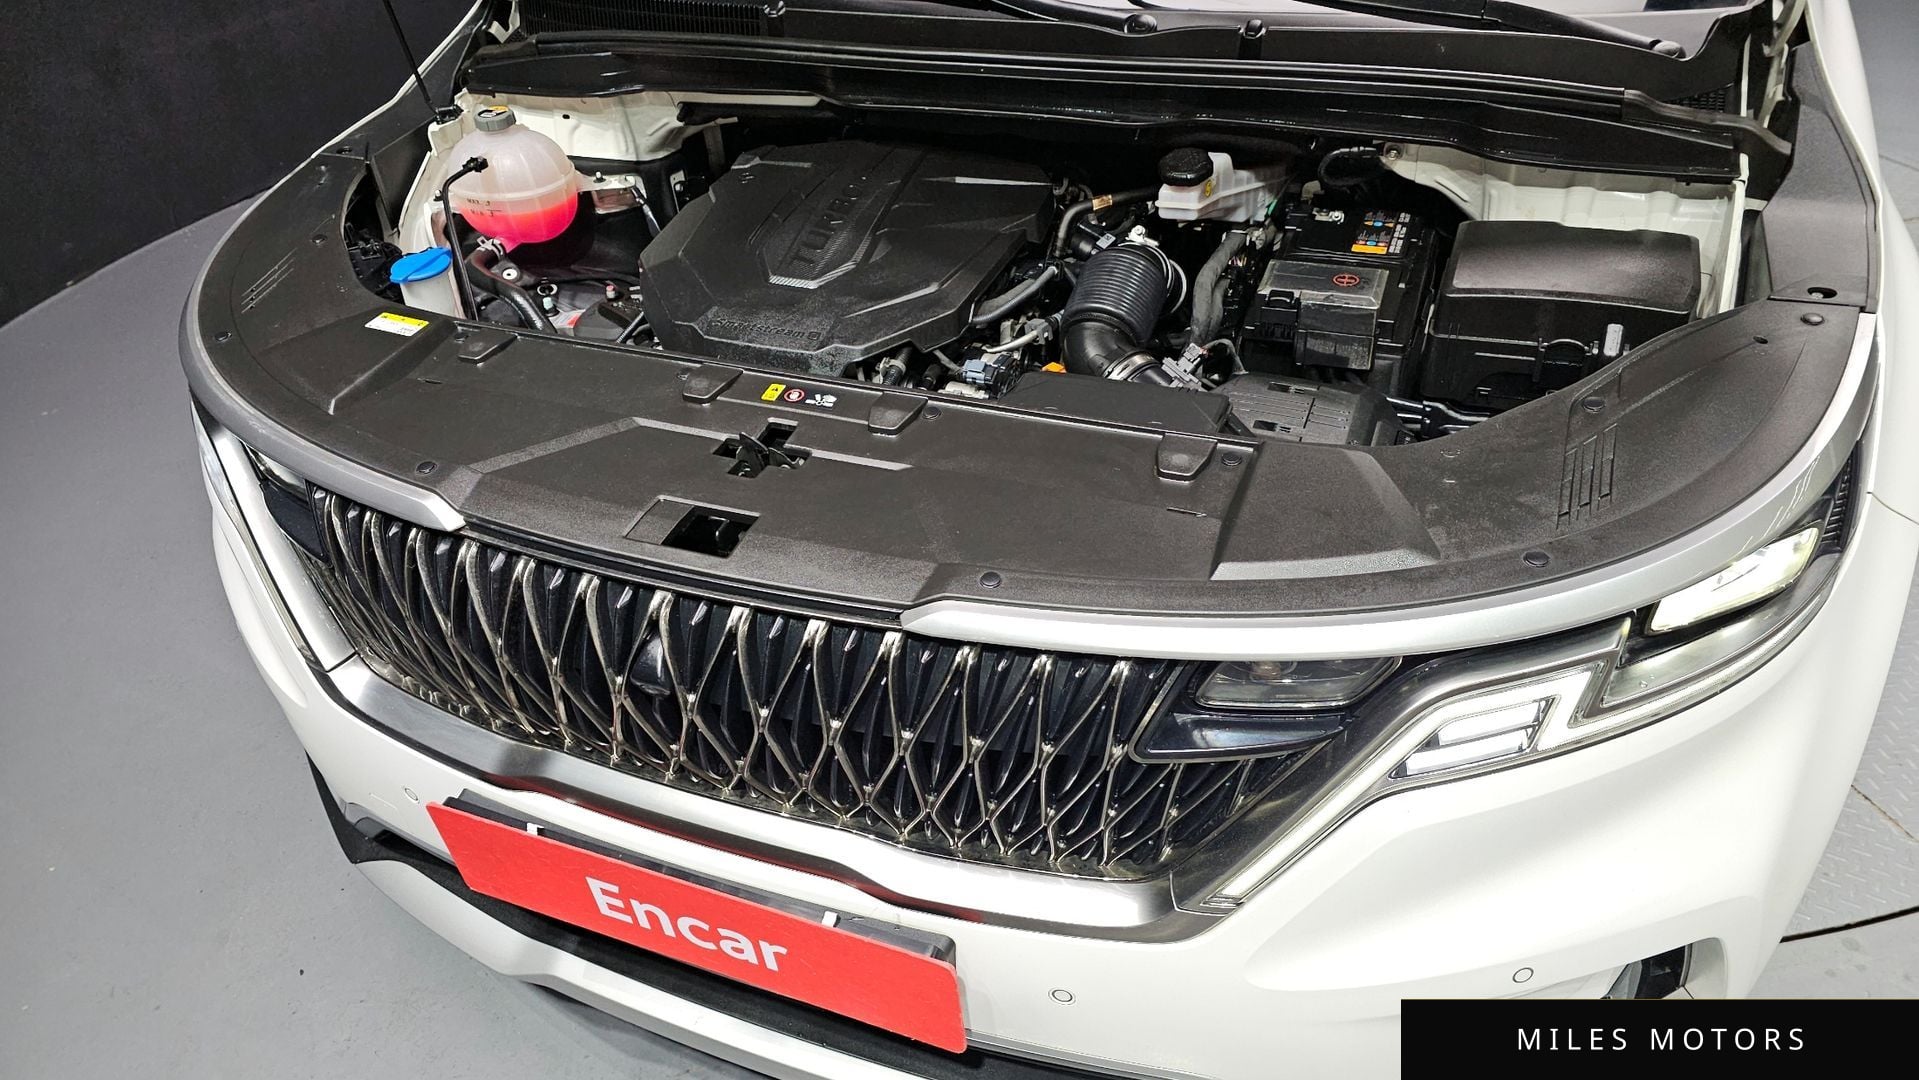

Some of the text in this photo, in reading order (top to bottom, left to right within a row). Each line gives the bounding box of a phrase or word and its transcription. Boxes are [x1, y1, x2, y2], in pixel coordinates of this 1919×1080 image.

[786, 184, 862, 267] TURBO
[712, 318, 805, 338] Smartstream
[585, 876, 788, 972] Encar
